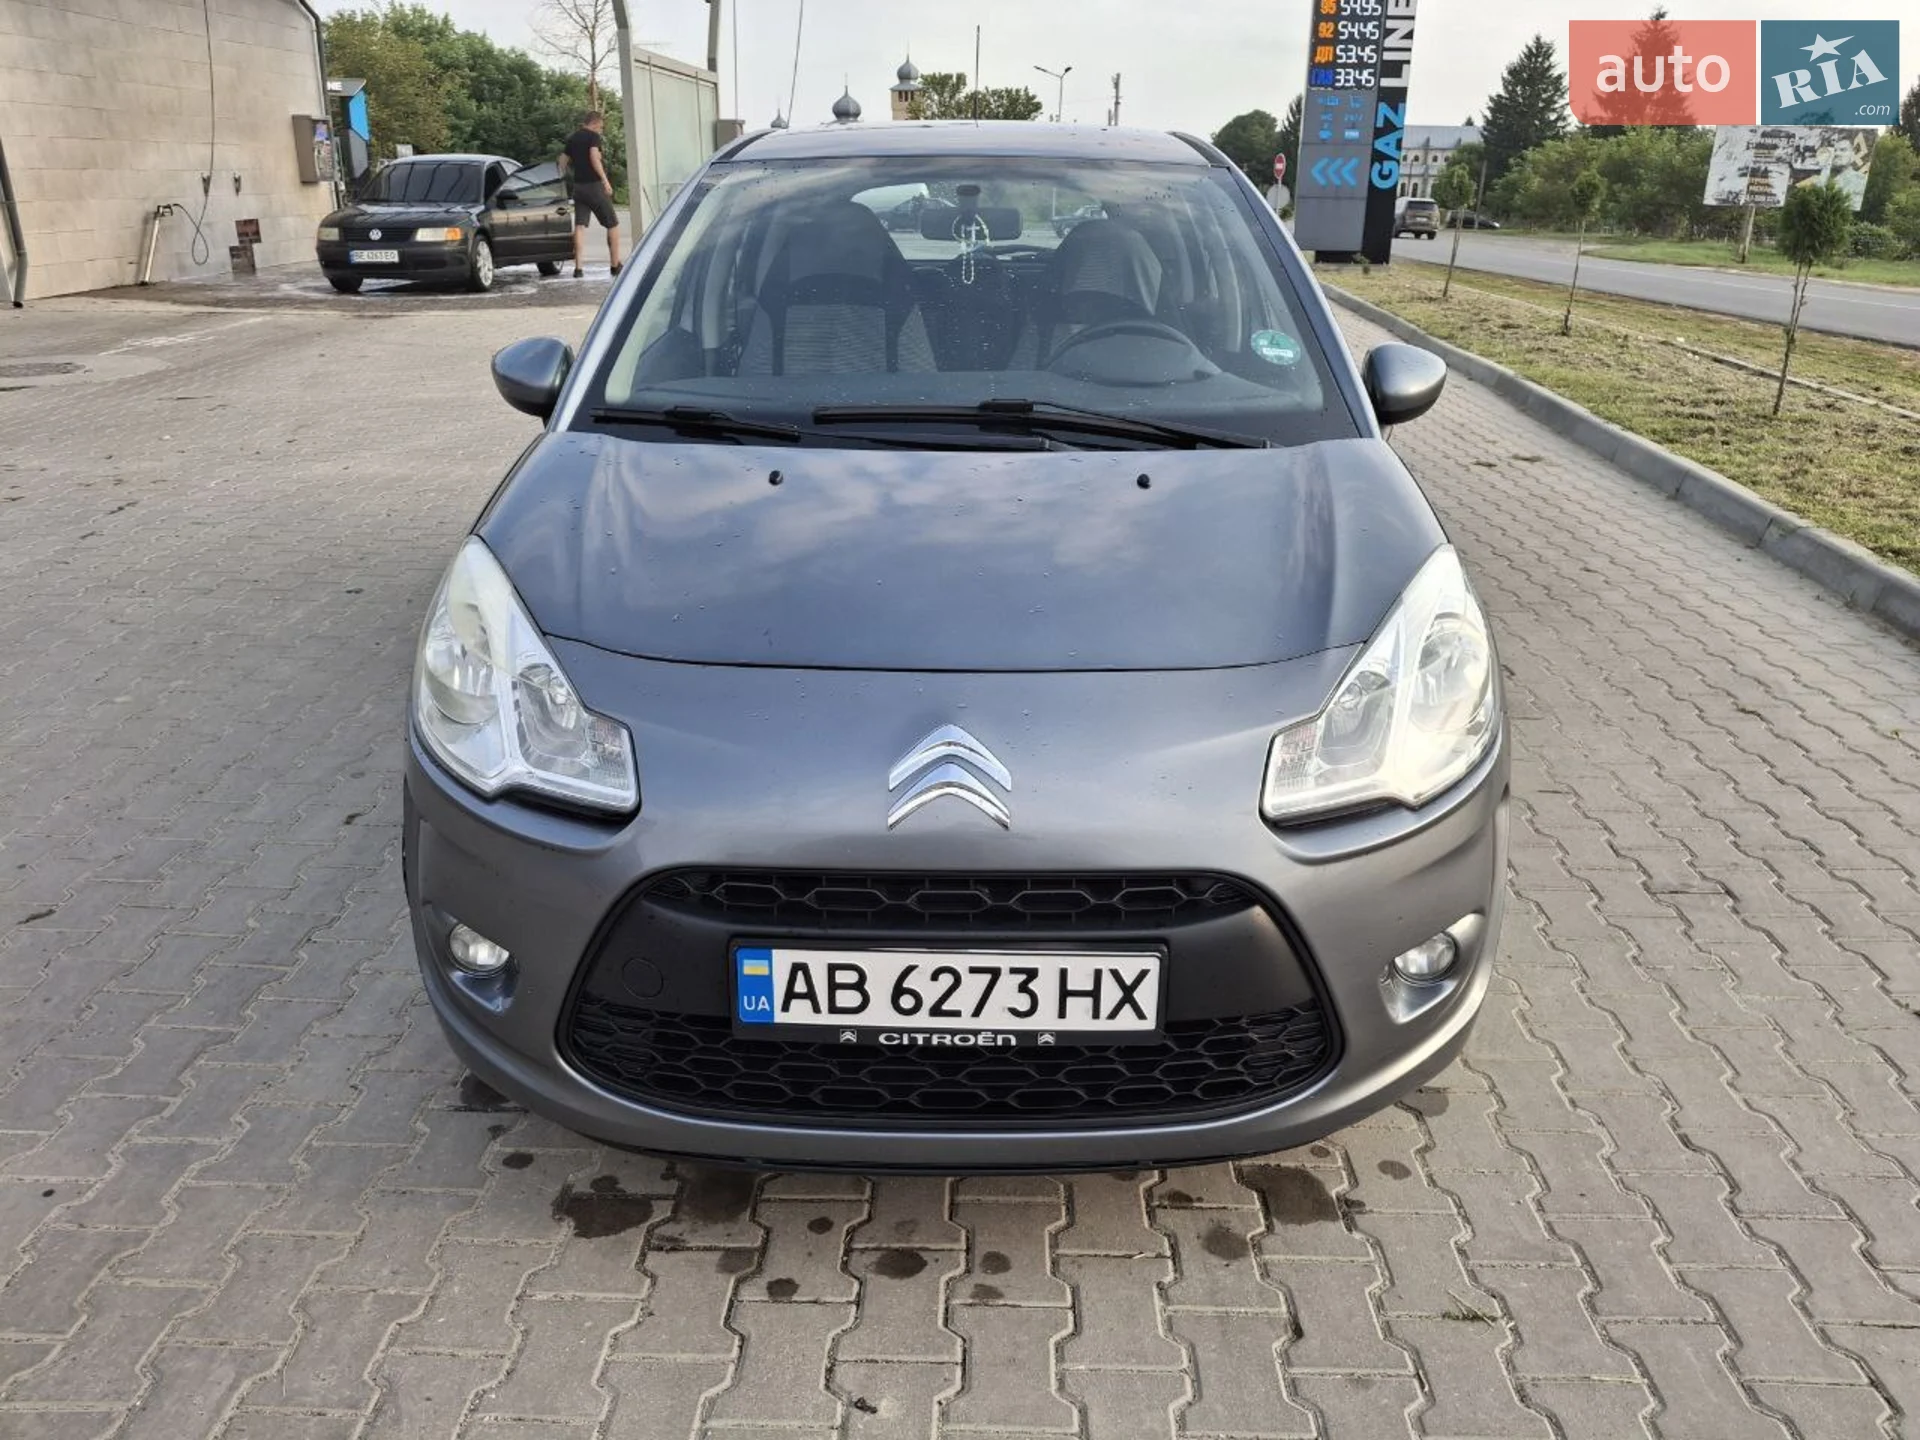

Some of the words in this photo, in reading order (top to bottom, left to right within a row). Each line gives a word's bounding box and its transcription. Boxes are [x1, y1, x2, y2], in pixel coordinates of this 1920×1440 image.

[1318, 22, 1335, 38] 92
[1379, 0, 1417, 88] LINE
[1371, 101, 1408, 189] GAZ
[743, 995, 770, 1012] UA
[781, 962, 871, 1015] AB
[890, 964, 1039, 1019] 6273
[1057, 967, 1151, 1020] HX
